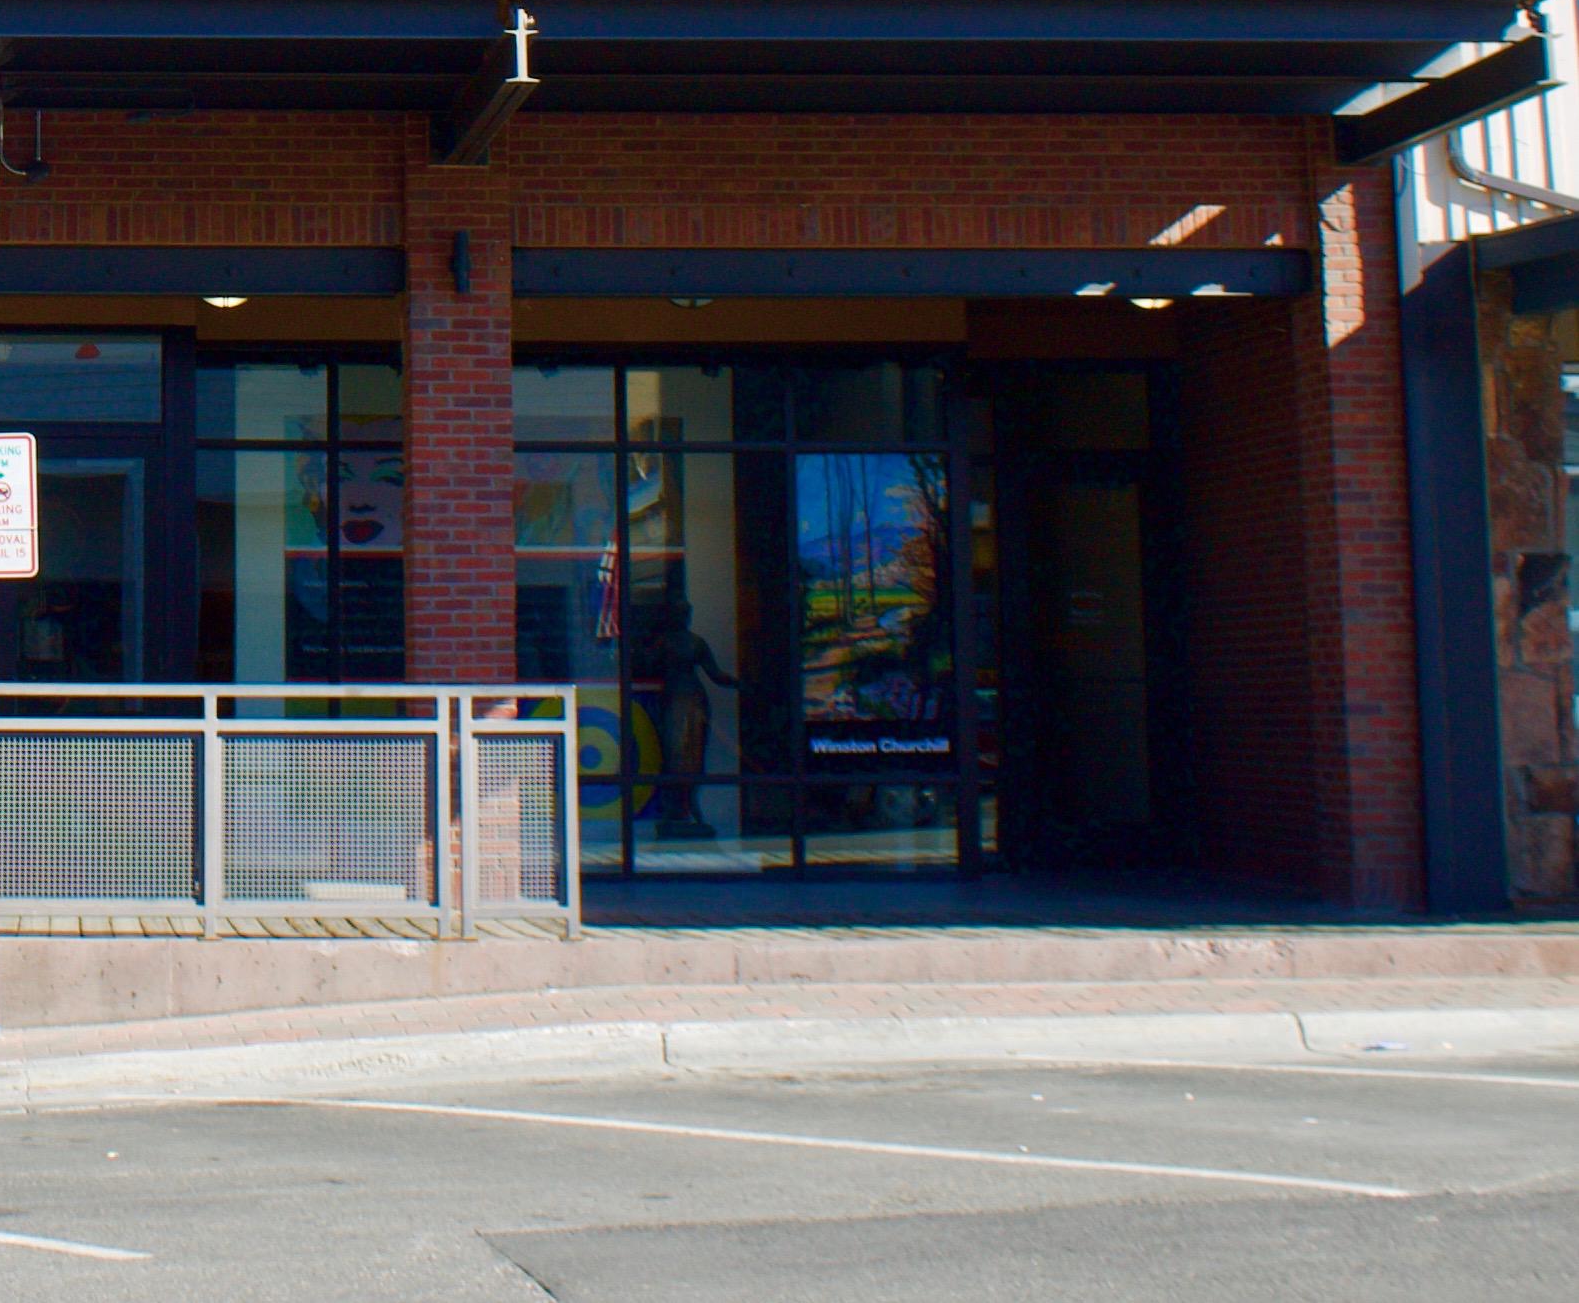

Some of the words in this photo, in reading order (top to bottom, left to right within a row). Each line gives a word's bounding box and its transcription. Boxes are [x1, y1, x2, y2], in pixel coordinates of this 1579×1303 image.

[16, 548, 26, 558] 15
[810, 737, 877, 754] Winston
[879, 736, 950, 754] Churchill
